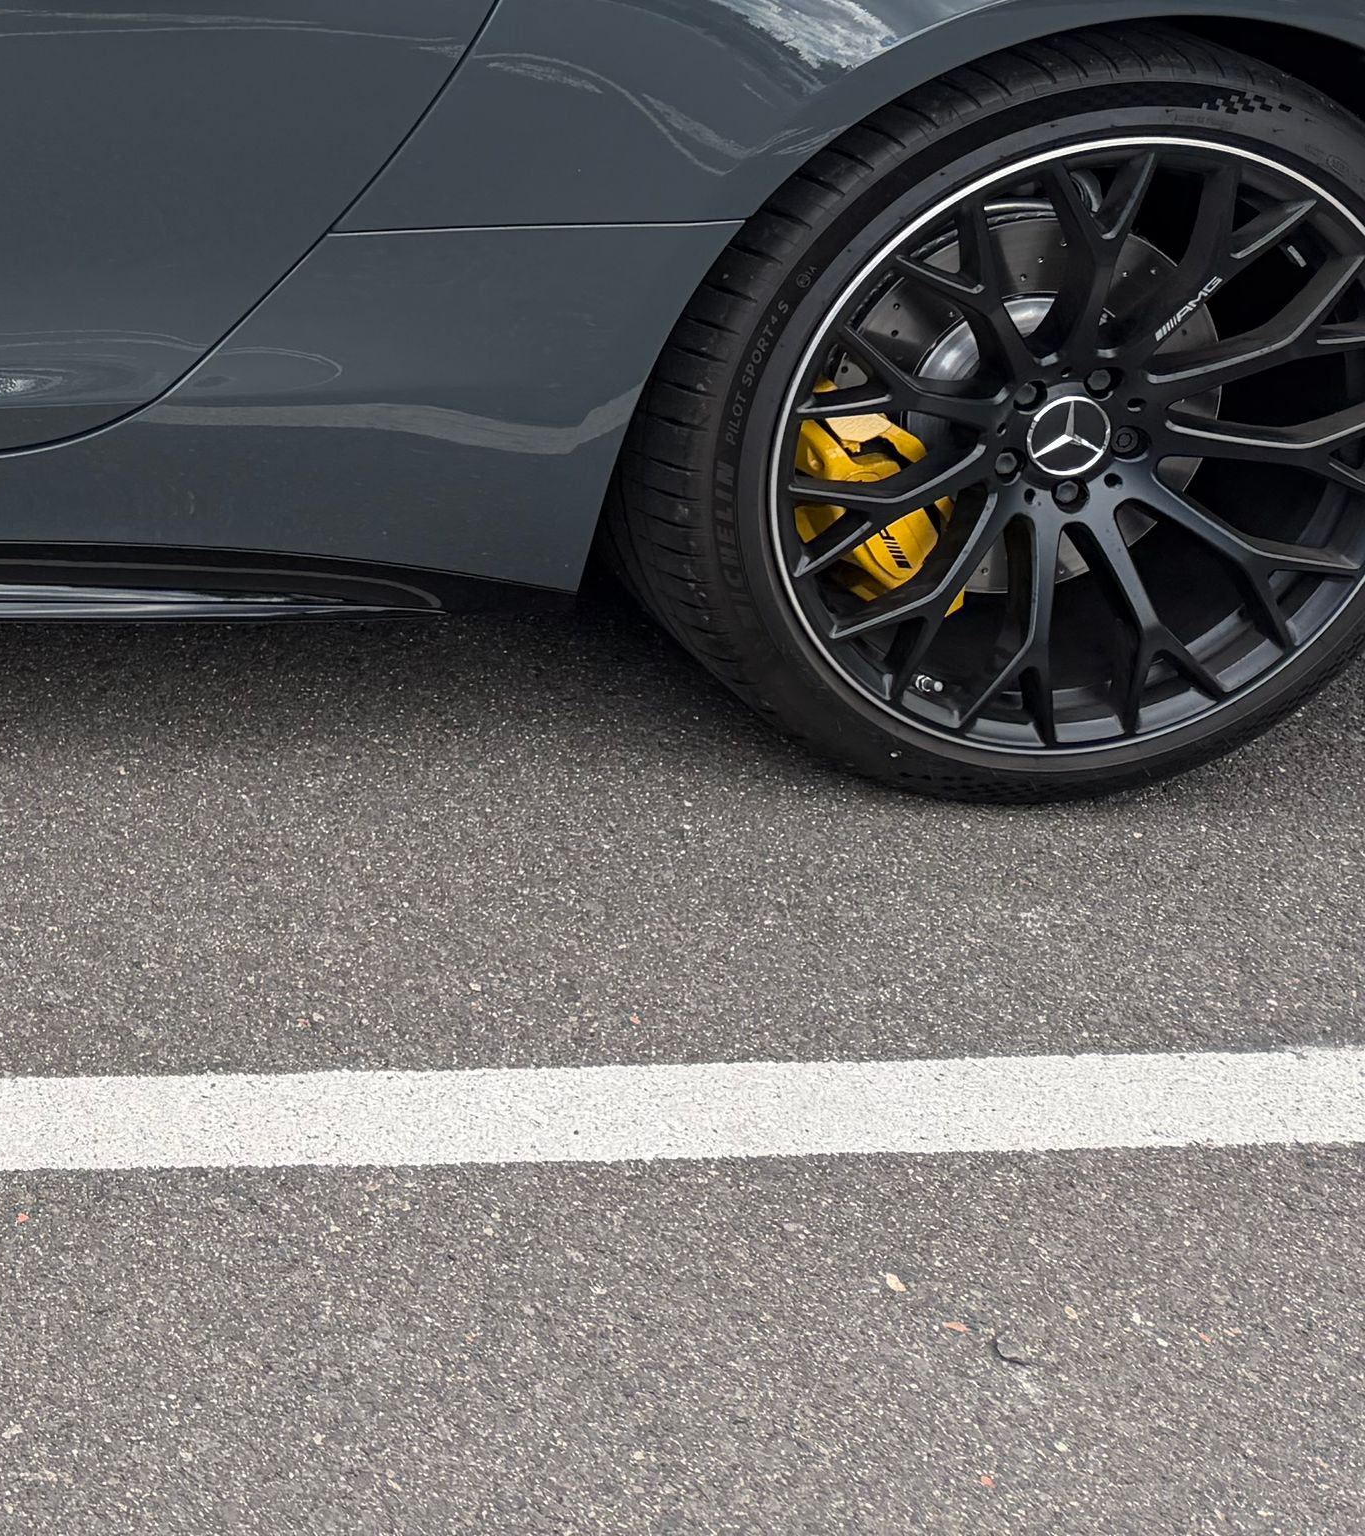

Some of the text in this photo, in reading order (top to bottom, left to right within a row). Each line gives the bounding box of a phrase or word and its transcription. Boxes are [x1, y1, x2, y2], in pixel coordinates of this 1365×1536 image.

[1176, 275, 1223, 323] AMG
[726, 392, 747, 445] PILOT
[742, 324, 774, 387] SPORT
[778, 300, 789, 314] S
